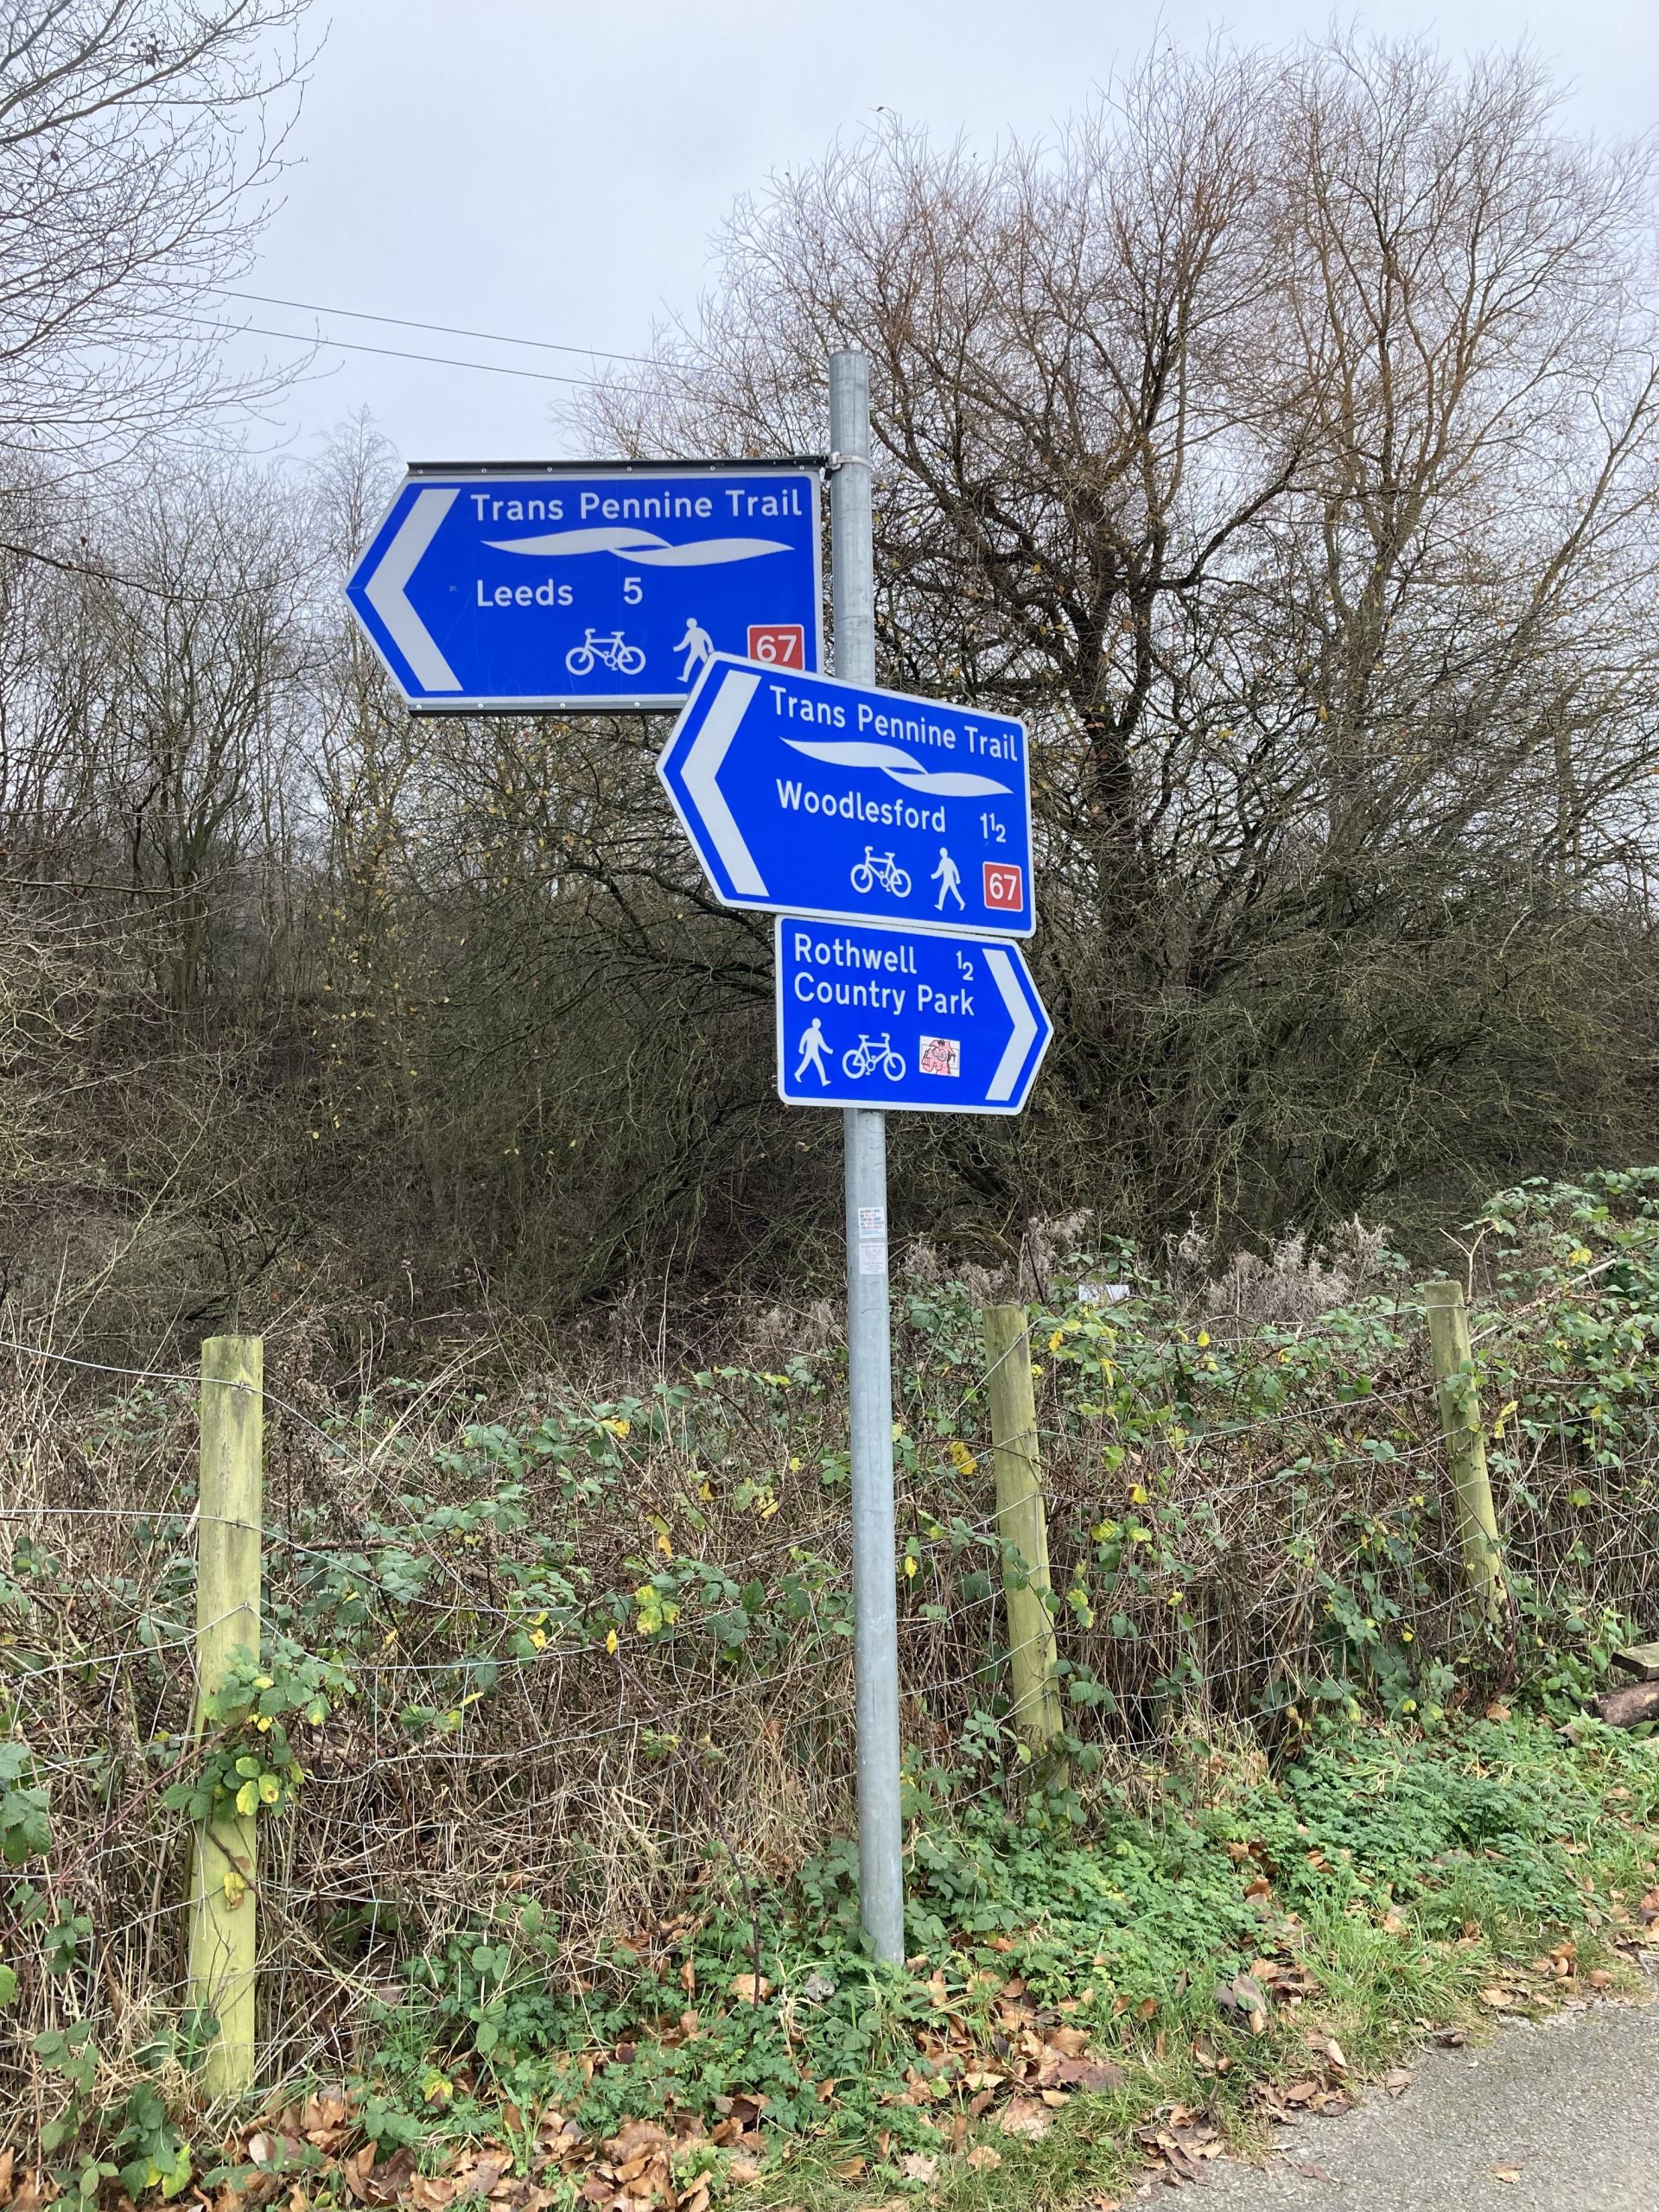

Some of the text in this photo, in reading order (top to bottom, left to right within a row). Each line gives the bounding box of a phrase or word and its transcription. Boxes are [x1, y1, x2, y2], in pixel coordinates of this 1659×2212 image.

[470, 489, 803, 521] Trans Pennine Trail
[477, 577, 644, 607] Leeds 5
[757, 635, 797, 663] 67
[769, 684, 1018, 762] Trans Pennine Trail
[776, 779, 947, 833] Woodlesford
[989, 872, 1017, 901] 67
[794, 932, 918, 975] Rothwell
[793, 971, 976, 1016] Country Park
